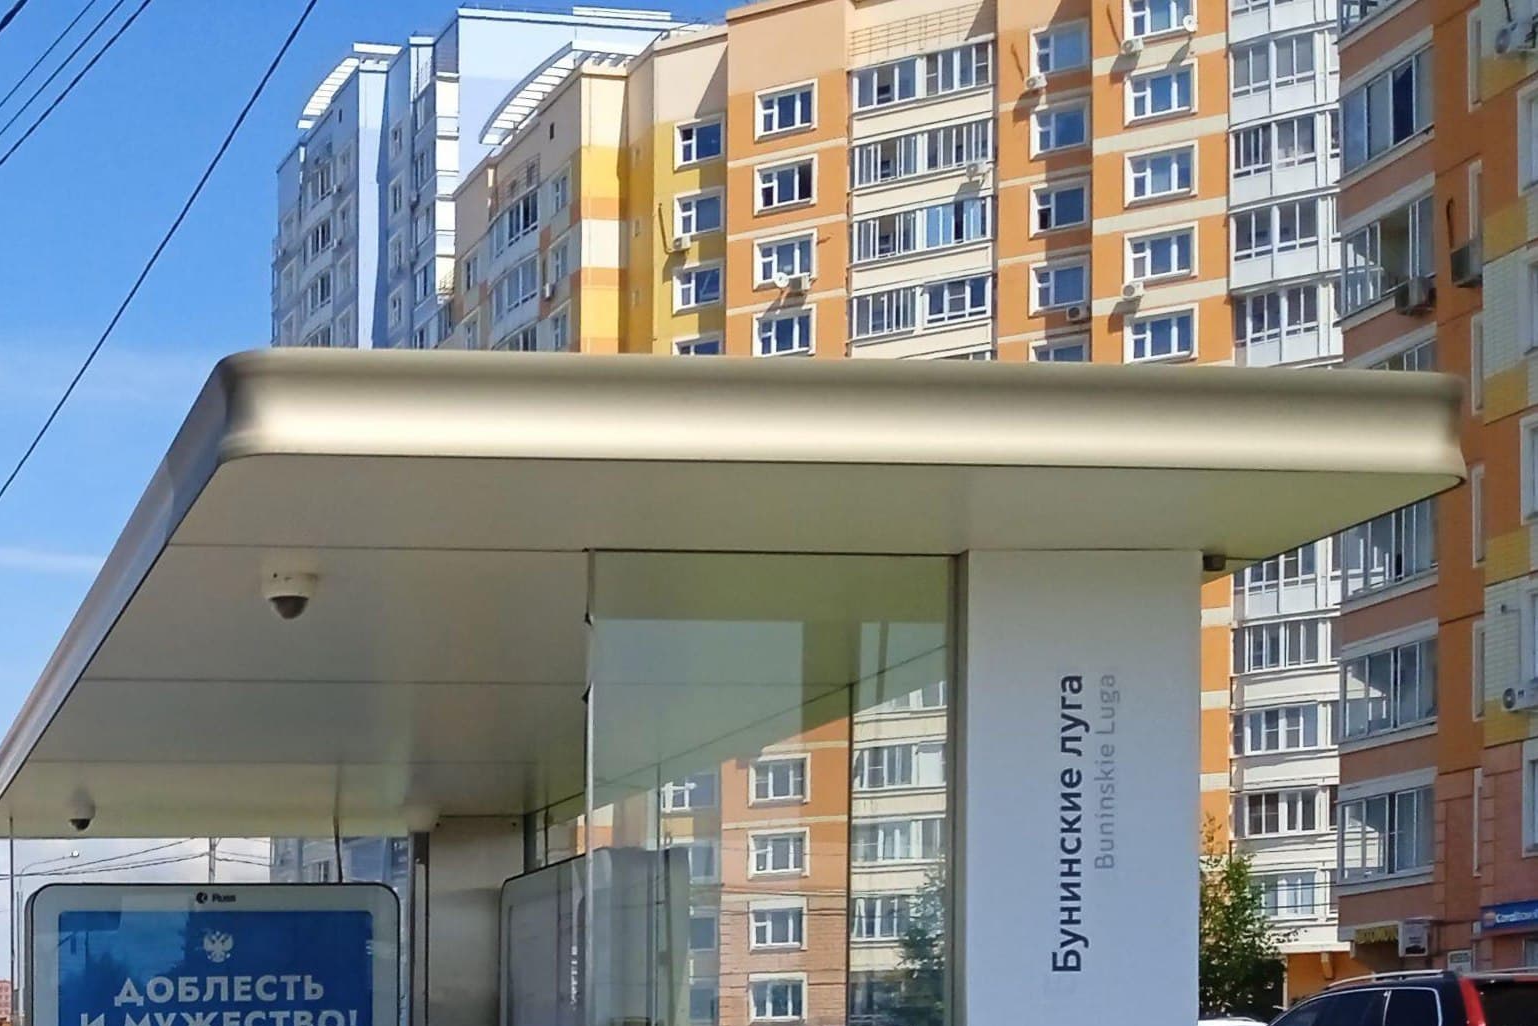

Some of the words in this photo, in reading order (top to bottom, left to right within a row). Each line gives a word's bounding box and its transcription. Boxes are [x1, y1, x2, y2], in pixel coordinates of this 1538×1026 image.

[1060, 674, 1090, 757] луга
[1095, 673, 1120, 735] Luga
[1094, 743, 1115, 870] Buninskie
[1051, 767, 1089, 972] Бунинские
[114, 974, 325, 1007] ДОБЛЕСТЬ
